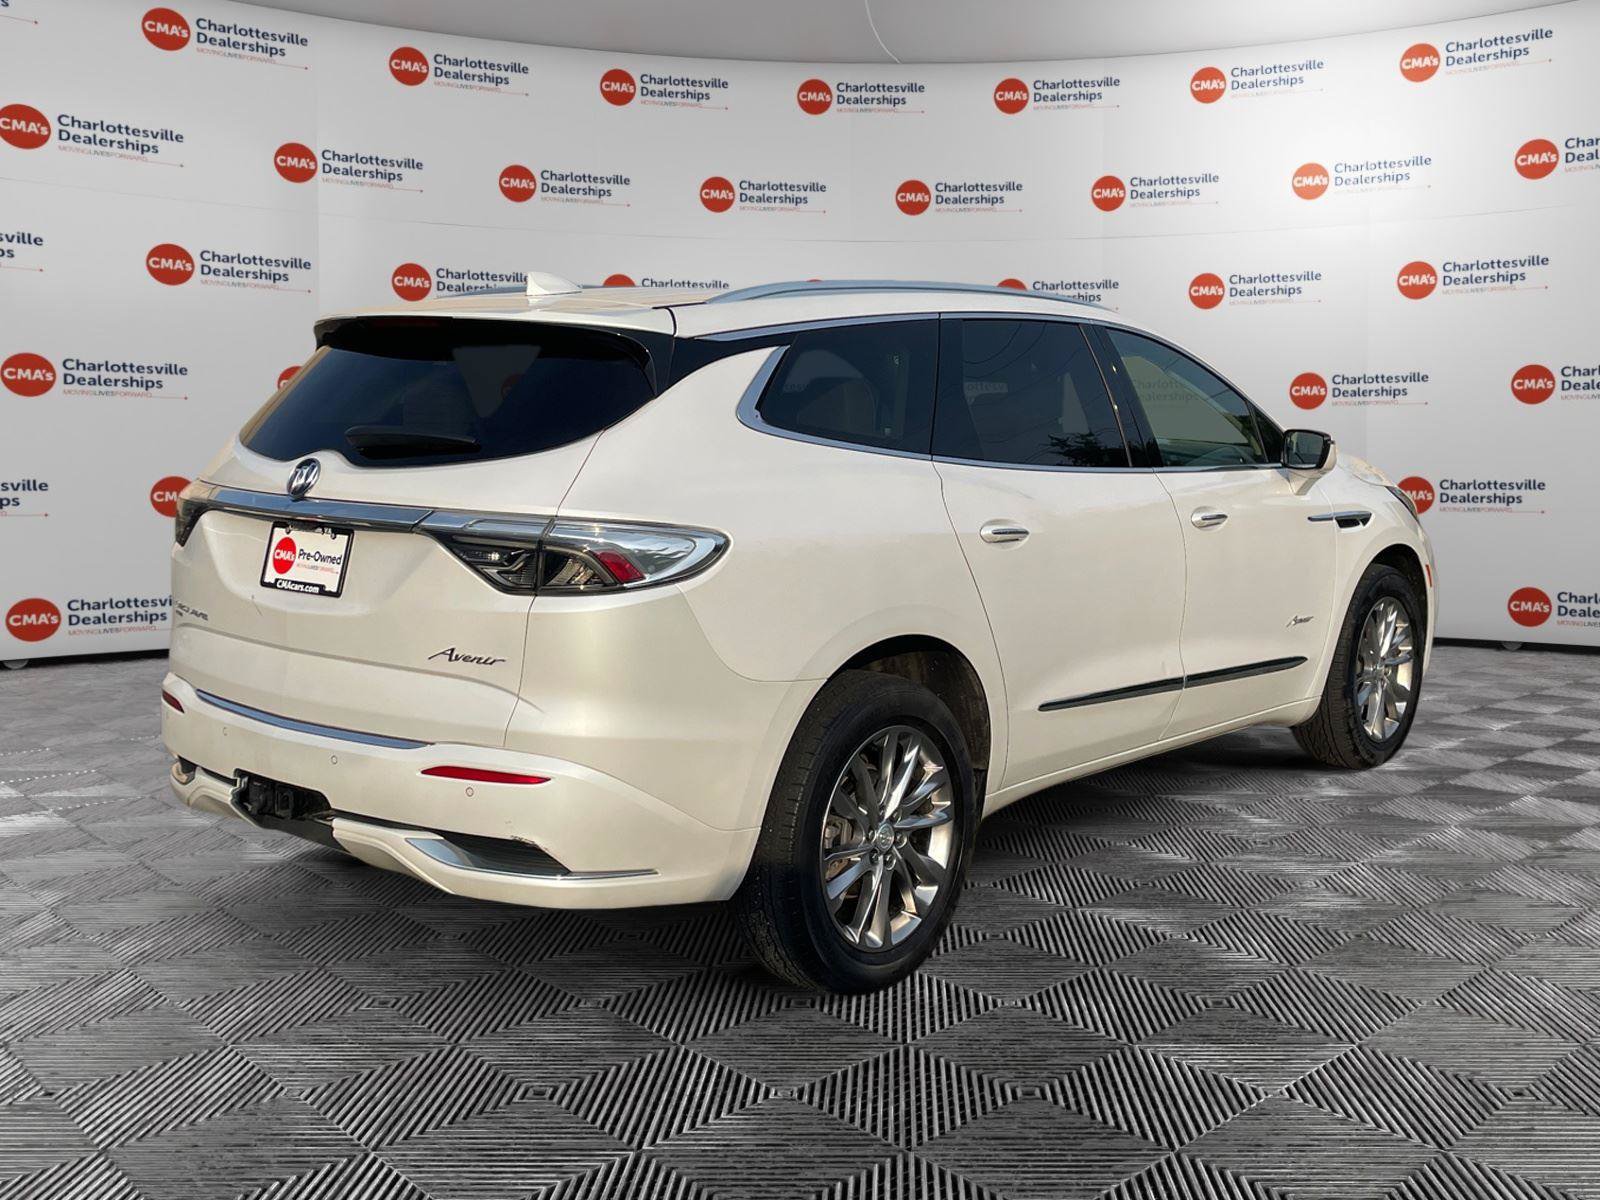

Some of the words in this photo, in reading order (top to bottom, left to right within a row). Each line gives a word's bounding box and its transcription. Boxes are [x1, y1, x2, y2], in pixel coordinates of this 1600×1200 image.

[144, 20, 189, 39] CMA's
[196, 18, 309, 47] Charlottesville
[197, 32, 285, 57] Dealerships
[1446, 29, 1553, 52] Charlottesville
[434, 54, 528, 74] Charlottesville
[1403, 55, 1438, 70] CMA's
[1447, 48, 1529, 66] Dealerships
[392, 59, 428, 74] CMA's
[1231, 60, 1323, 77] Charlottesville
[434, 67, 509, 86] Dealerships
[641, 74, 728, 88] Charlottesville
[1033, 77, 1120, 90] Charlottesville
[1232, 77, 1303, 90] Dealerships
[603, 81, 634, 94] CMA's
[837, 83, 924, 92] Charlottesville
[1192, 78, 1224, 92] CMA's
[641, 87, 710, 102] Dealerships
[800, 91, 830, 102] CMA's
[837, 95, 906, 107] Dealerships
[996, 90, 1027, 102] CMA's
[1034, 91, 1102, 102] Dealerships
[0, 117, 49, 136] CMA's
[58, 114, 183, 142] Charlottesville
[59, 129, 158, 154] Dealerships
[276, 155, 316, 170] CMA's
[322, 150, 423, 169] Charlottesville
[1335, 156, 1431, 173] Charlottesville
[1516, 151, 1557, 167] CMA's
[323, 163, 402, 183] Dealerships
[541, 170, 630, 185] Charlottesville
[1335, 172, 1410, 185] Dealerships
[501, 177, 534, 190] CMA's
[739, 180, 826, 192] Charlottesville
[935, 182, 1022, 192] Charlottesville
[1130, 174, 1218, 187] Charlottesville
[541, 183, 611, 199] Dealerships
[702, 188, 733, 200] CMA's
[896, 192, 929, 203] CMA's
[1093, 187, 1124, 199] CMA's
[1131, 187, 1200, 199] Dealerships
[740, 193, 808, 206] Dealerships
[936, 195, 1004, 206] Dealerships
[148, 256, 192, 272] CMA's
[200, 250, 311, 269] Charlottesville
[1443, 255, 1549, 272] Charlottesville
[201, 264, 289, 283] Dealerships
[1229, 272, 1321, 284] Charlottesville
[1400, 273, 1436, 287] CMA's
[1443, 271, 1525, 286] Dealerships
[395, 275, 430, 289] CMA's
[641, 278, 730, 289] Charlottesville
[1033, 280, 1119, 290] Charlottesville
[1191, 285, 1223, 297] CMA's
[1230, 286, 1301, 297] Dealerships
[3, 367, 54, 381] CMA's
[63, 359, 187, 375] Charlottesville
[64, 373, 163, 391] Dealerships
[1332, 372, 1428, 385] Charlottesville
[1513, 377, 1554, 390] CMA's
[1292, 385, 1326, 396] CMA's
[1332, 386, 1407, 399] Dealerships
[1440, 479, 1545, 490] Charlottesville
[1406, 489, 1433, 501] MA's
[1440, 493, 1522, 506] Dealerships
[274, 549, 296, 562] CMA's
[298, 549, 342, 565] Pre-Owned
[276, 580, 320, 594] CMAcars.com
[68, 595, 172, 611] Charlottesvi
[1557, 592, 1600, 604] Charl
[1509, 600, 1550, 613] CMA's
[8, 612, 59, 627] CMA's
[69, 611, 167, 626] Dealerships
[428, 647, 506, 665] Avenir
